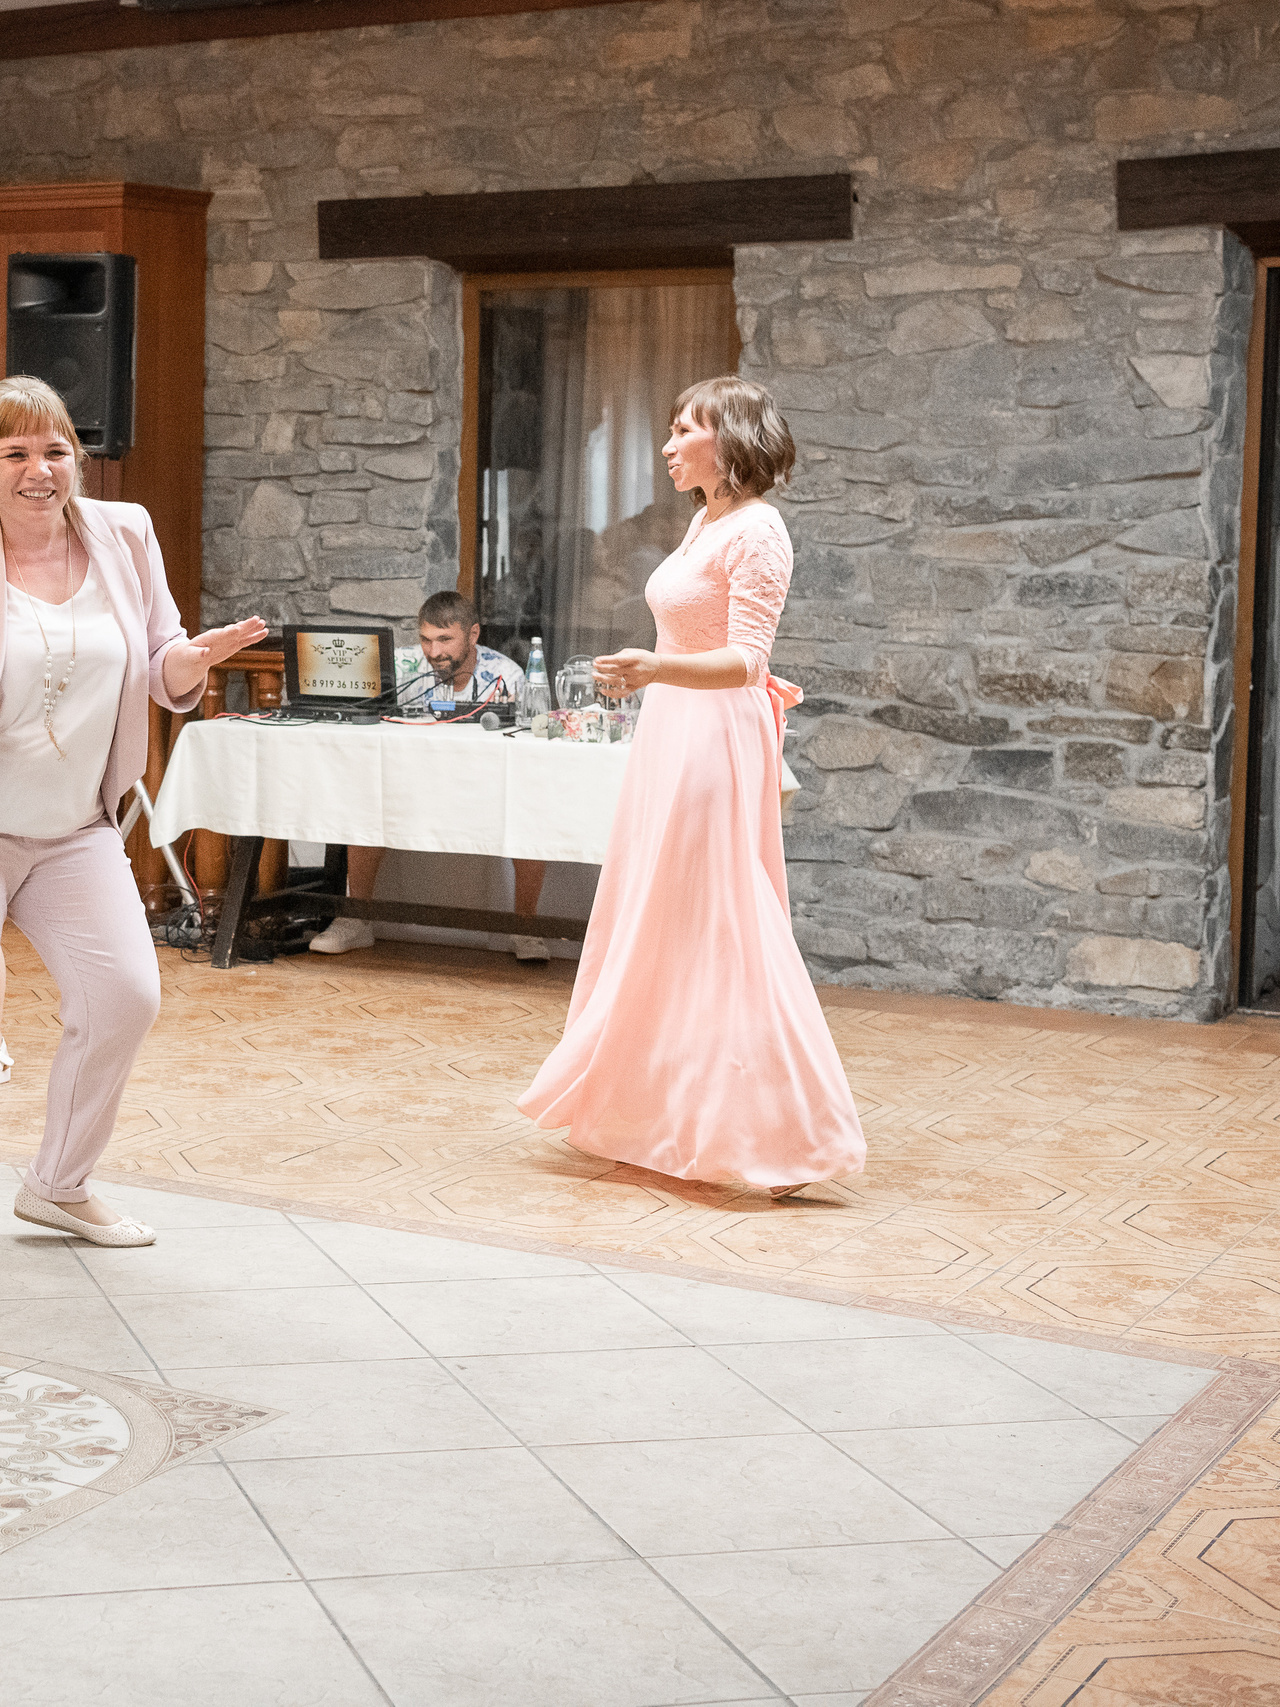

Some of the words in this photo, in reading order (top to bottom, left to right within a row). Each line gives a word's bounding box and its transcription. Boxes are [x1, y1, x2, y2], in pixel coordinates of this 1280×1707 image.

[332, 649, 348, 657] VIP
[312, 679, 317, 687] 8
[320, 679, 334, 688] 919
[337, 680, 347, 689] 36
[350, 680, 359, 689] 15
[361, 681, 377, 690] 392
